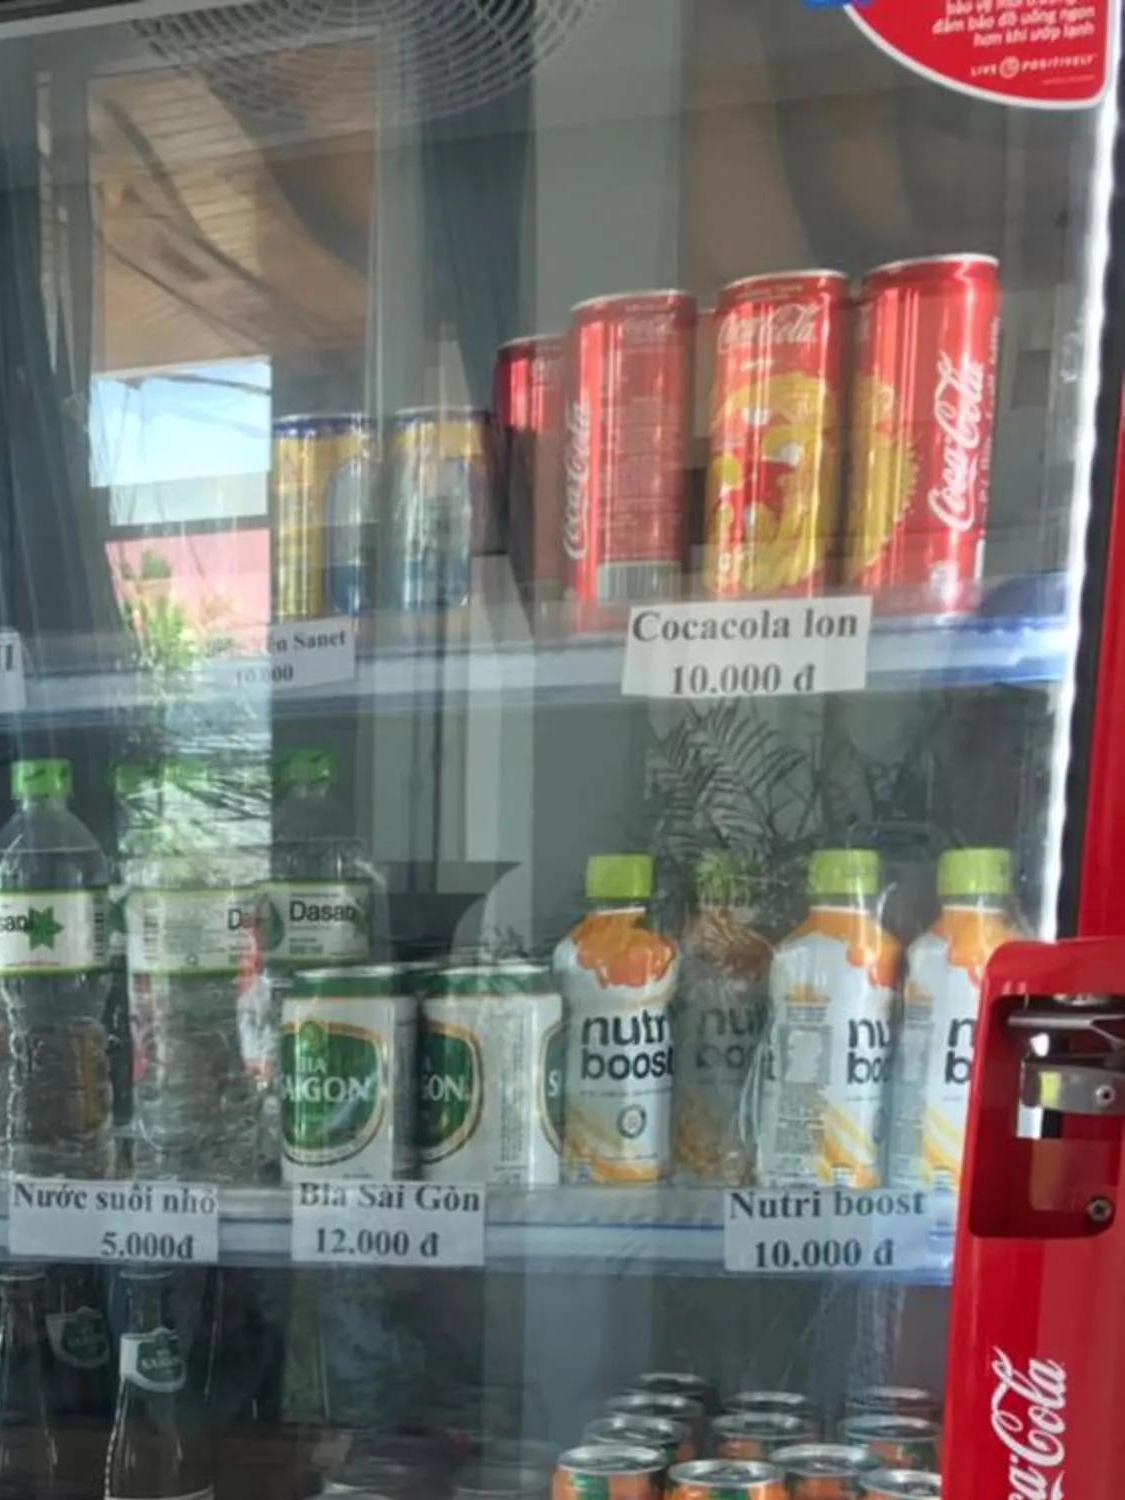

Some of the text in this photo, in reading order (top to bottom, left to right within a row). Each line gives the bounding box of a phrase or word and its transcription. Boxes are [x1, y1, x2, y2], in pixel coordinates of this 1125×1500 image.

[632, 608, 858, 642] Cocacola lon
[673, 664, 782, 695] 10.000
[290, 901, 355, 922] Dasan
[416, 1185, 480, 1212] Gòn
[730, 1191, 925, 1219] Nutri boost
[316, 1227, 410, 1256] 12.000
[756, 1239, 861, 1268] 10.000
